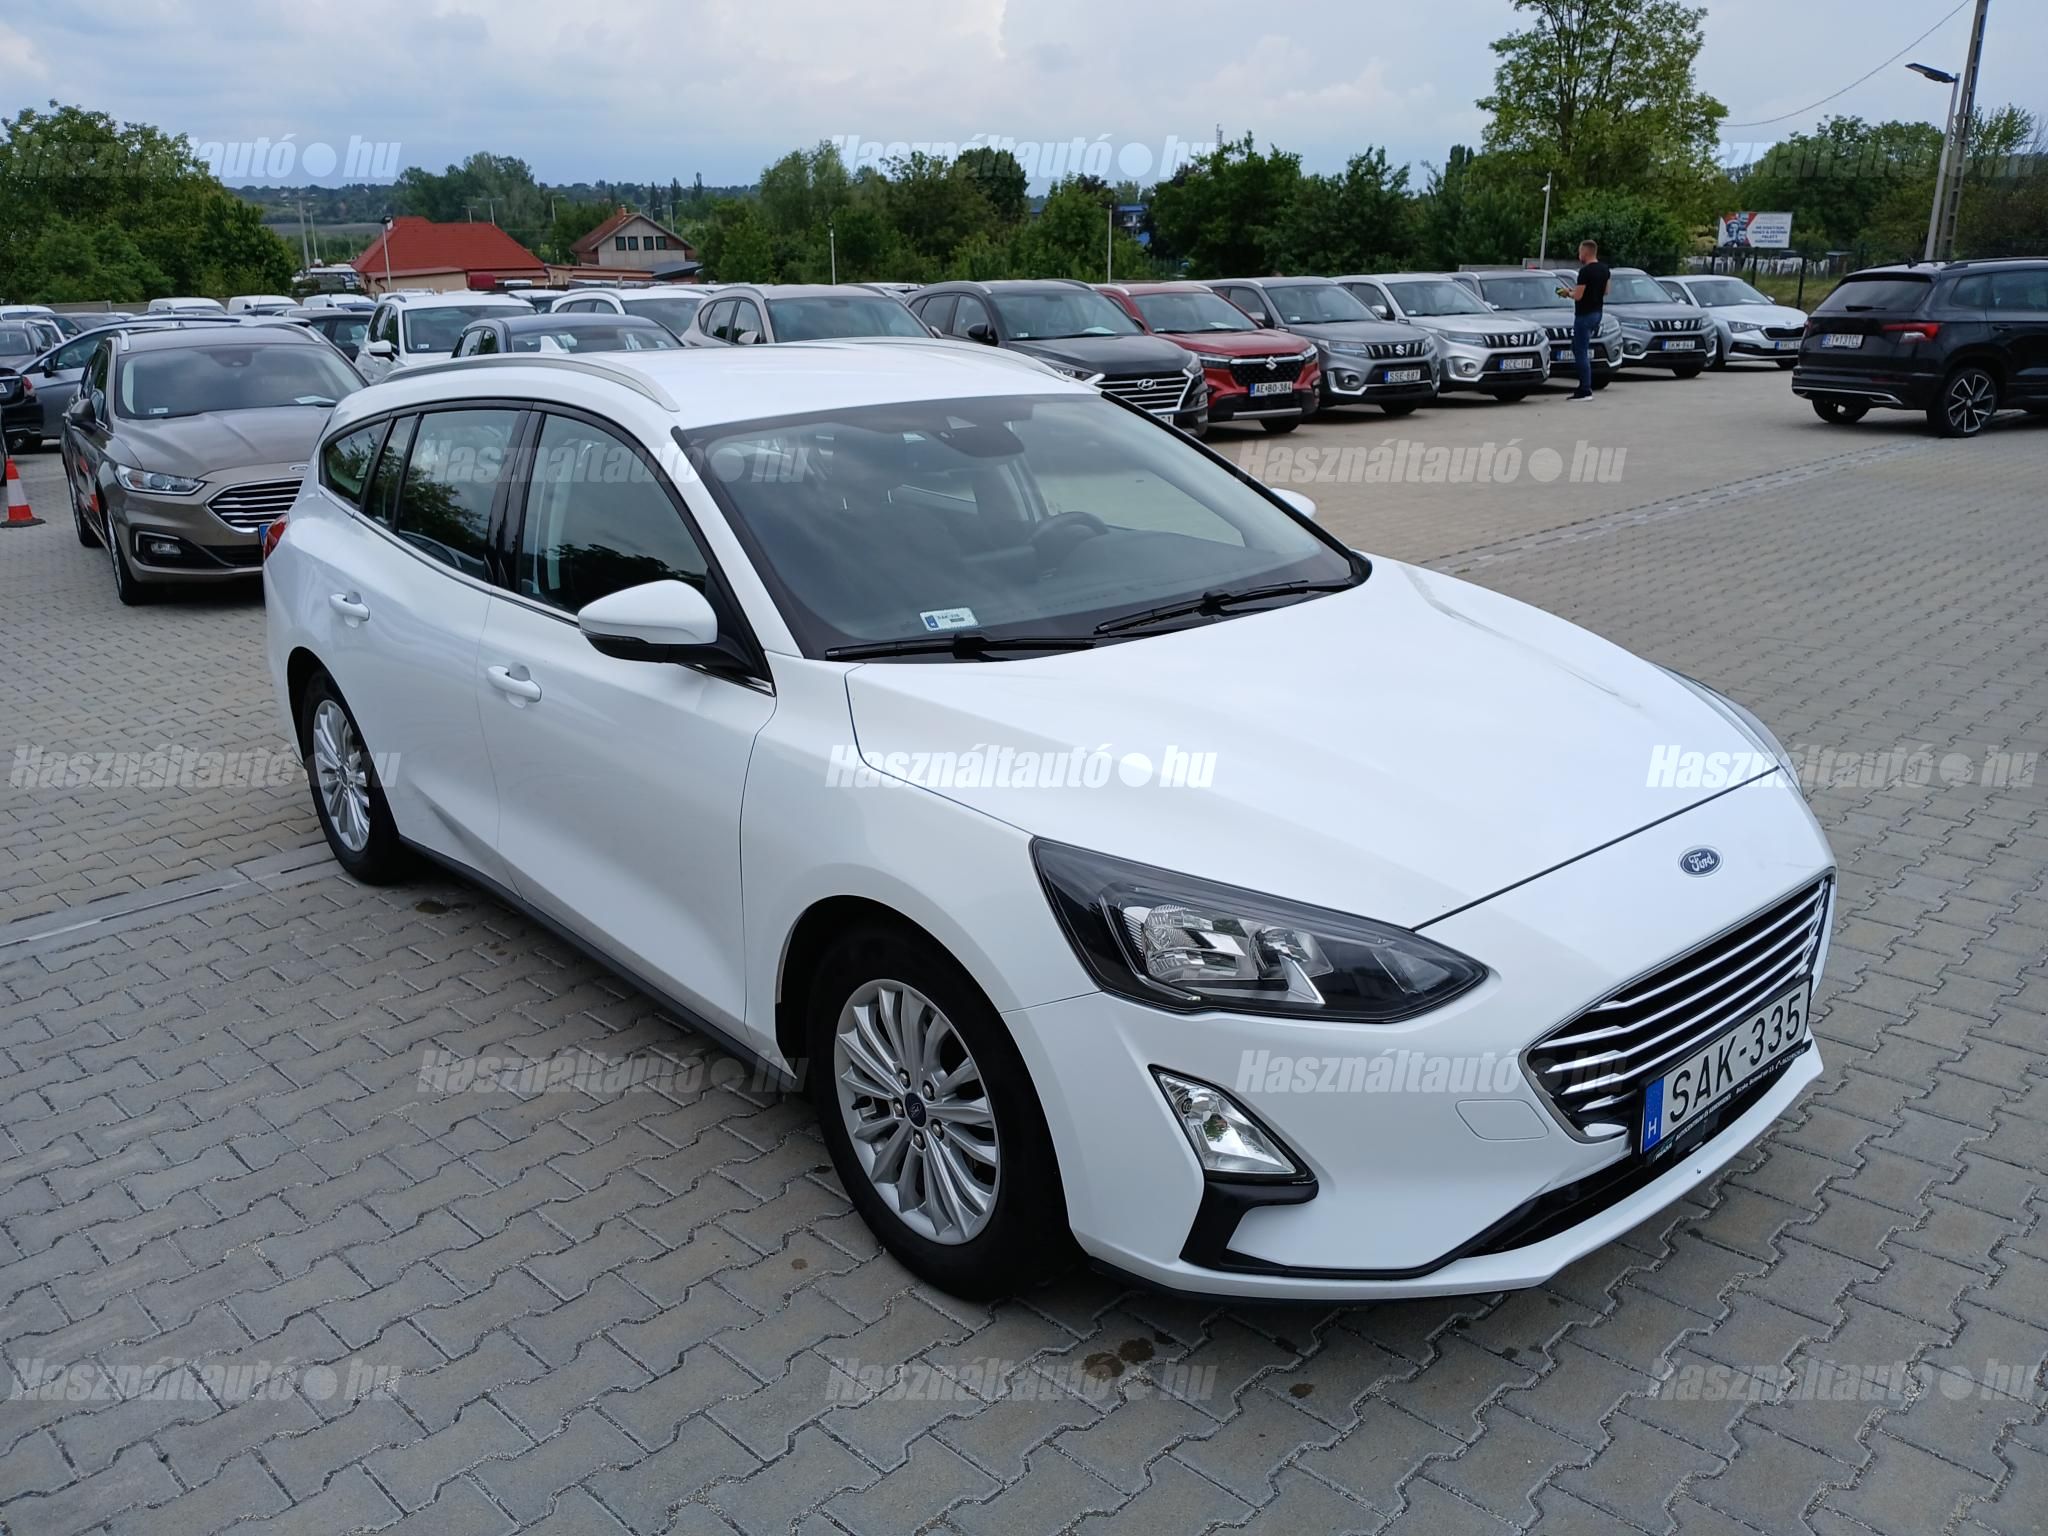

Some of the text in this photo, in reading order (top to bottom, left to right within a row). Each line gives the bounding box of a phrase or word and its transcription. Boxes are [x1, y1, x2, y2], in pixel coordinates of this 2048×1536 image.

[1688, 852, 1715, 872] Ford
[1647, 1117, 1658, 1140] H
[1669, 991, 1802, 1123] SAK-335
